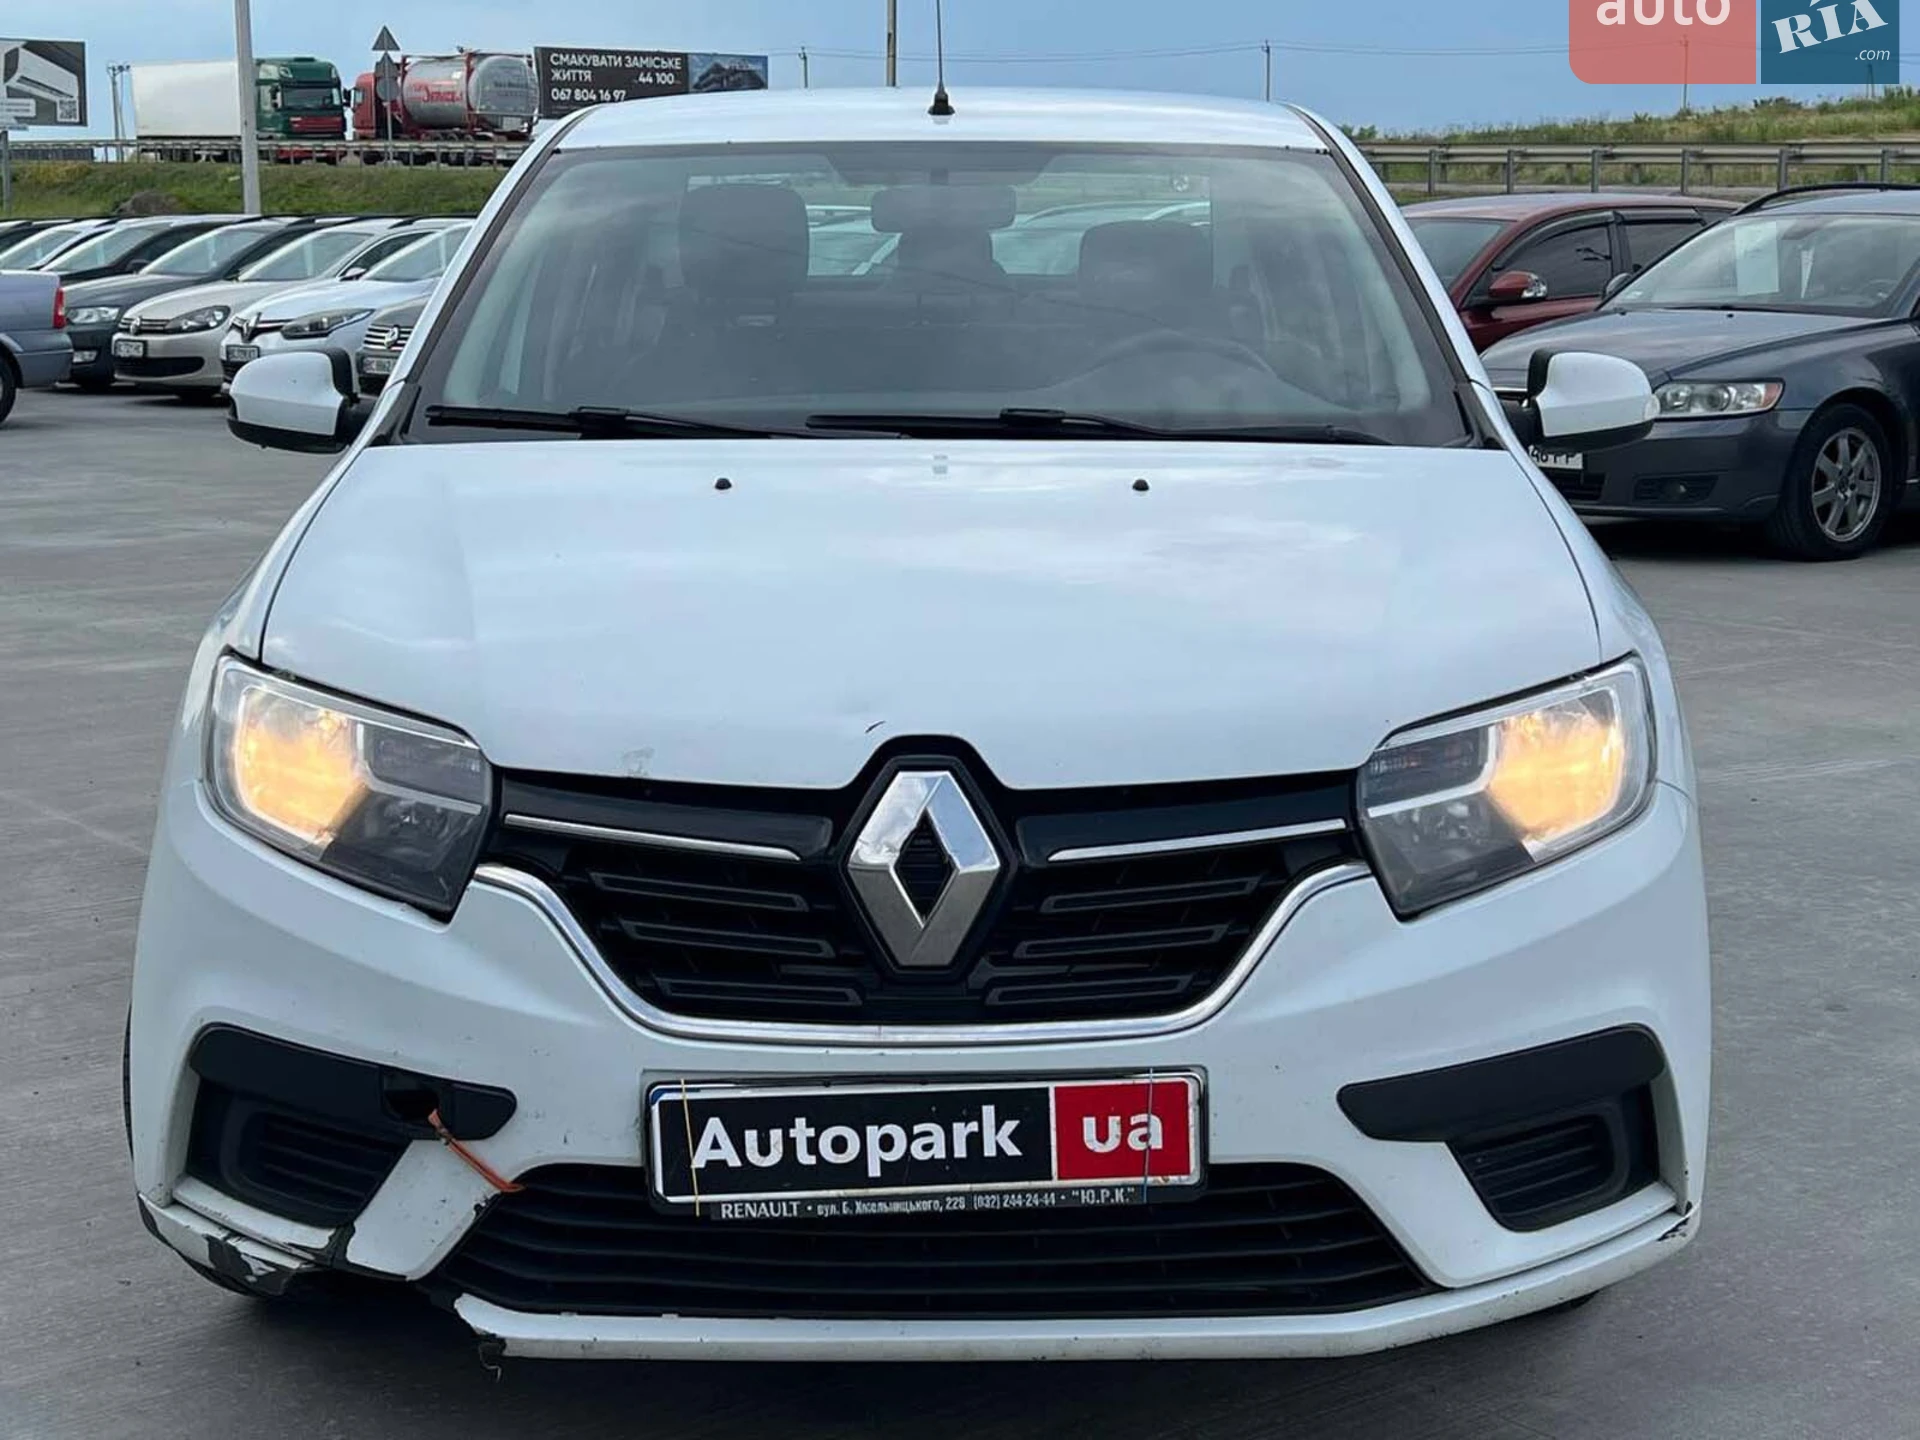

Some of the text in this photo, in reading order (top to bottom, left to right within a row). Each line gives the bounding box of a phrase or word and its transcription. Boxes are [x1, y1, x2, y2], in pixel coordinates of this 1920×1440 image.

[550, 53, 682, 70] СМАКУВАТИ ЗАМІСЬКЕ
[550, 70, 592, 82] ЖИТТЯ
[638, 72, 674, 85] 44 100
[551, 89, 626, 102] 067 804 16 97
[691, 1105, 1164, 1178] Autopark ua
[720, 1201, 800, 1219] RENAULT
